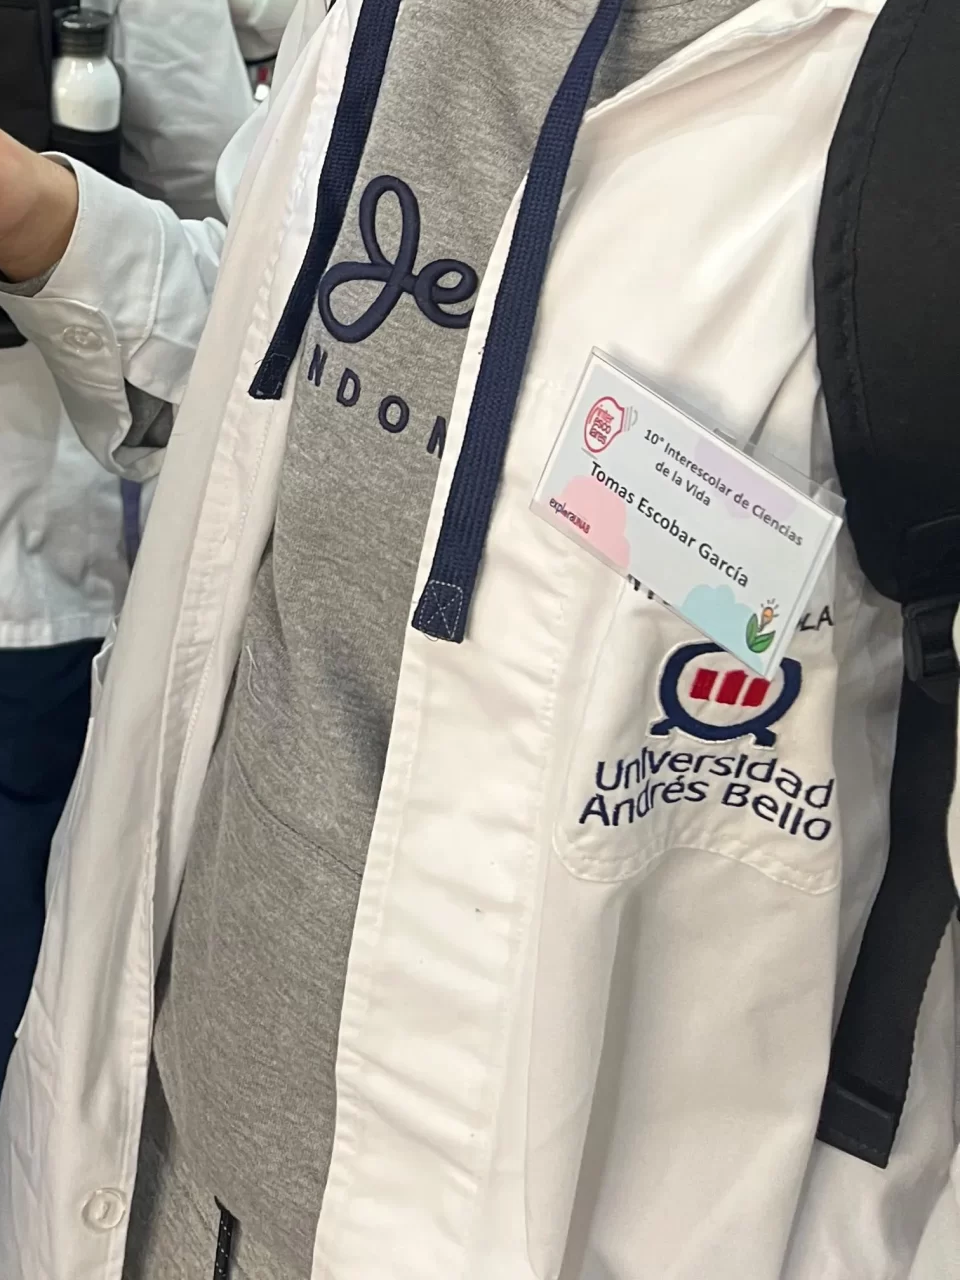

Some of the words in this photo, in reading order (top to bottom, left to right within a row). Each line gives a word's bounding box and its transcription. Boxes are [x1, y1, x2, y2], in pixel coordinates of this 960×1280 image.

[307, 344, 447, 459] NDON
[590, 461, 635, 504] Tomas
[637, 497, 697, 548] Escobar
[698, 543, 749, 587] García
[655, 461, 671, 477] de
[671, 471, 682, 486] la
[686, 479, 711, 506] Vida
[663, 443, 732, 497] Interescolar
[734, 493, 750, 510] de
[752, 504, 804, 547] Ciencias
[578, 775, 709, 827] Andrés
[721, 782, 832, 841] Bello
[595, 746, 835, 809] Universidad
